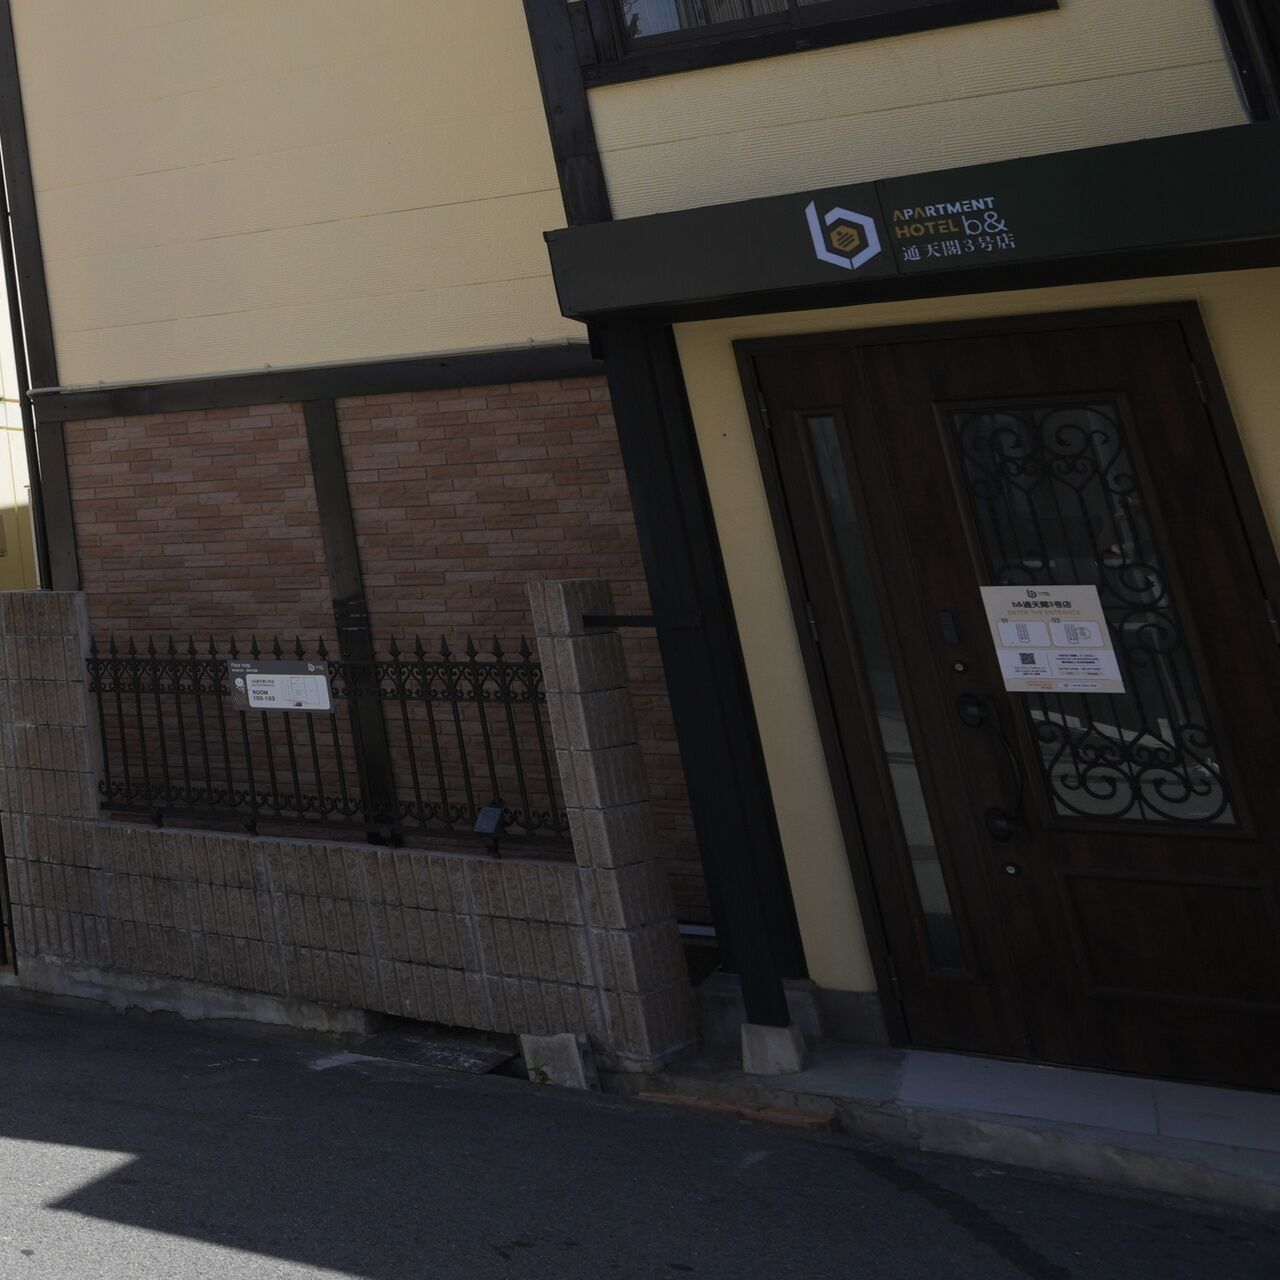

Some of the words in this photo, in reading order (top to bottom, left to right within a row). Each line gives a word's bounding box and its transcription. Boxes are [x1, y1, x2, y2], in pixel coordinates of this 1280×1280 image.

[892, 196, 995, 222] APARTMENT
[895, 219, 959, 239] HOTEL
[961, 211, 1009, 236] b&
[901, 233, 1017, 261] 通天閣3号店
